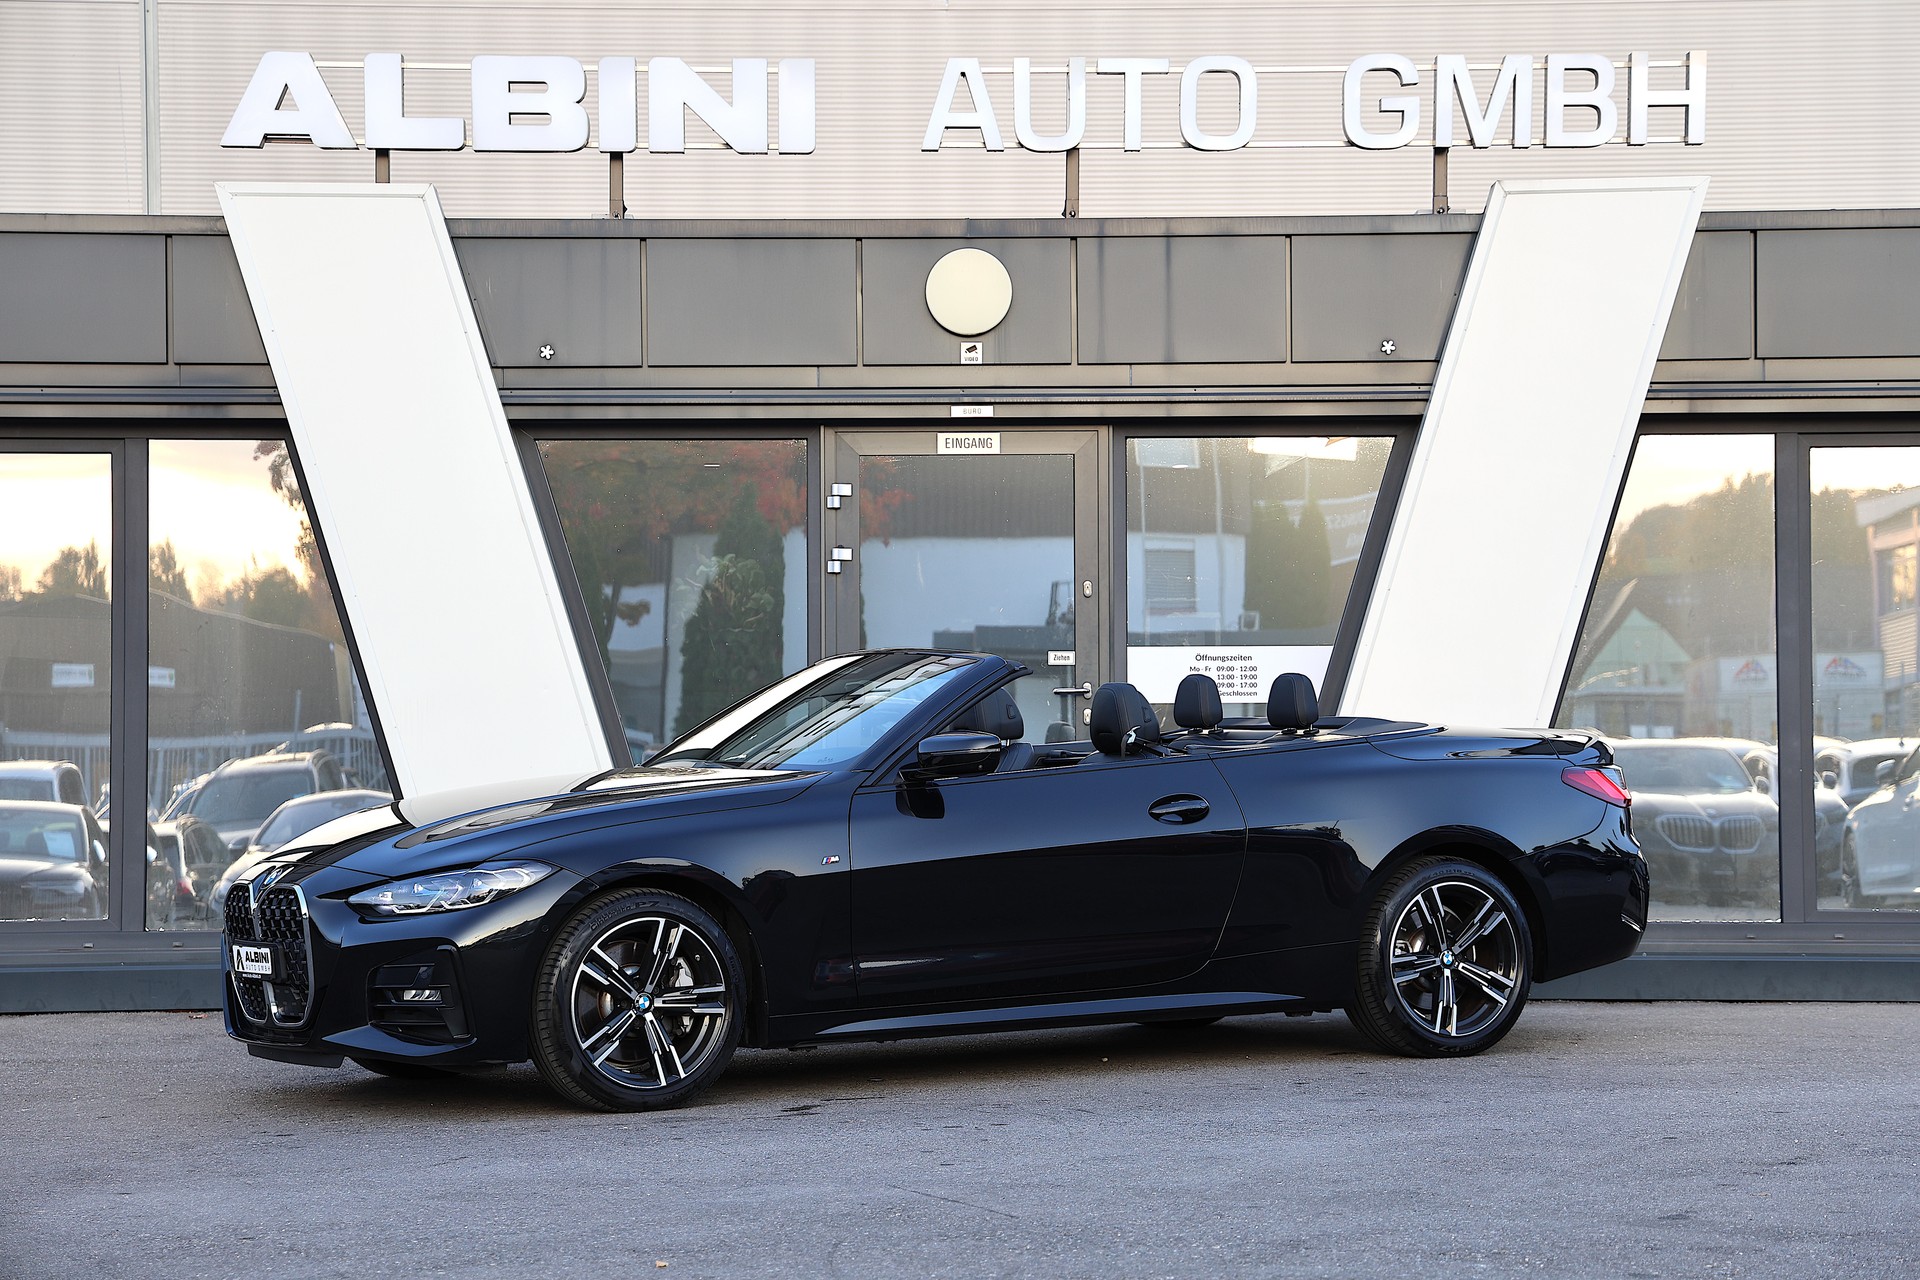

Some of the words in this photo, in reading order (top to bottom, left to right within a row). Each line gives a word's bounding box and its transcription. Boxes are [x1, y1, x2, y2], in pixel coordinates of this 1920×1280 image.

[219, 51, 816, 154] ALBINI
[921, 55, 1258, 153] AUTO
[1342, 50, 1708, 151] GMBH
[945, 437, 993, 449] EINGANG
[1195, 653, 1253, 662] Öffnungszeiten
[245, 951, 270, 964] ALBINI
